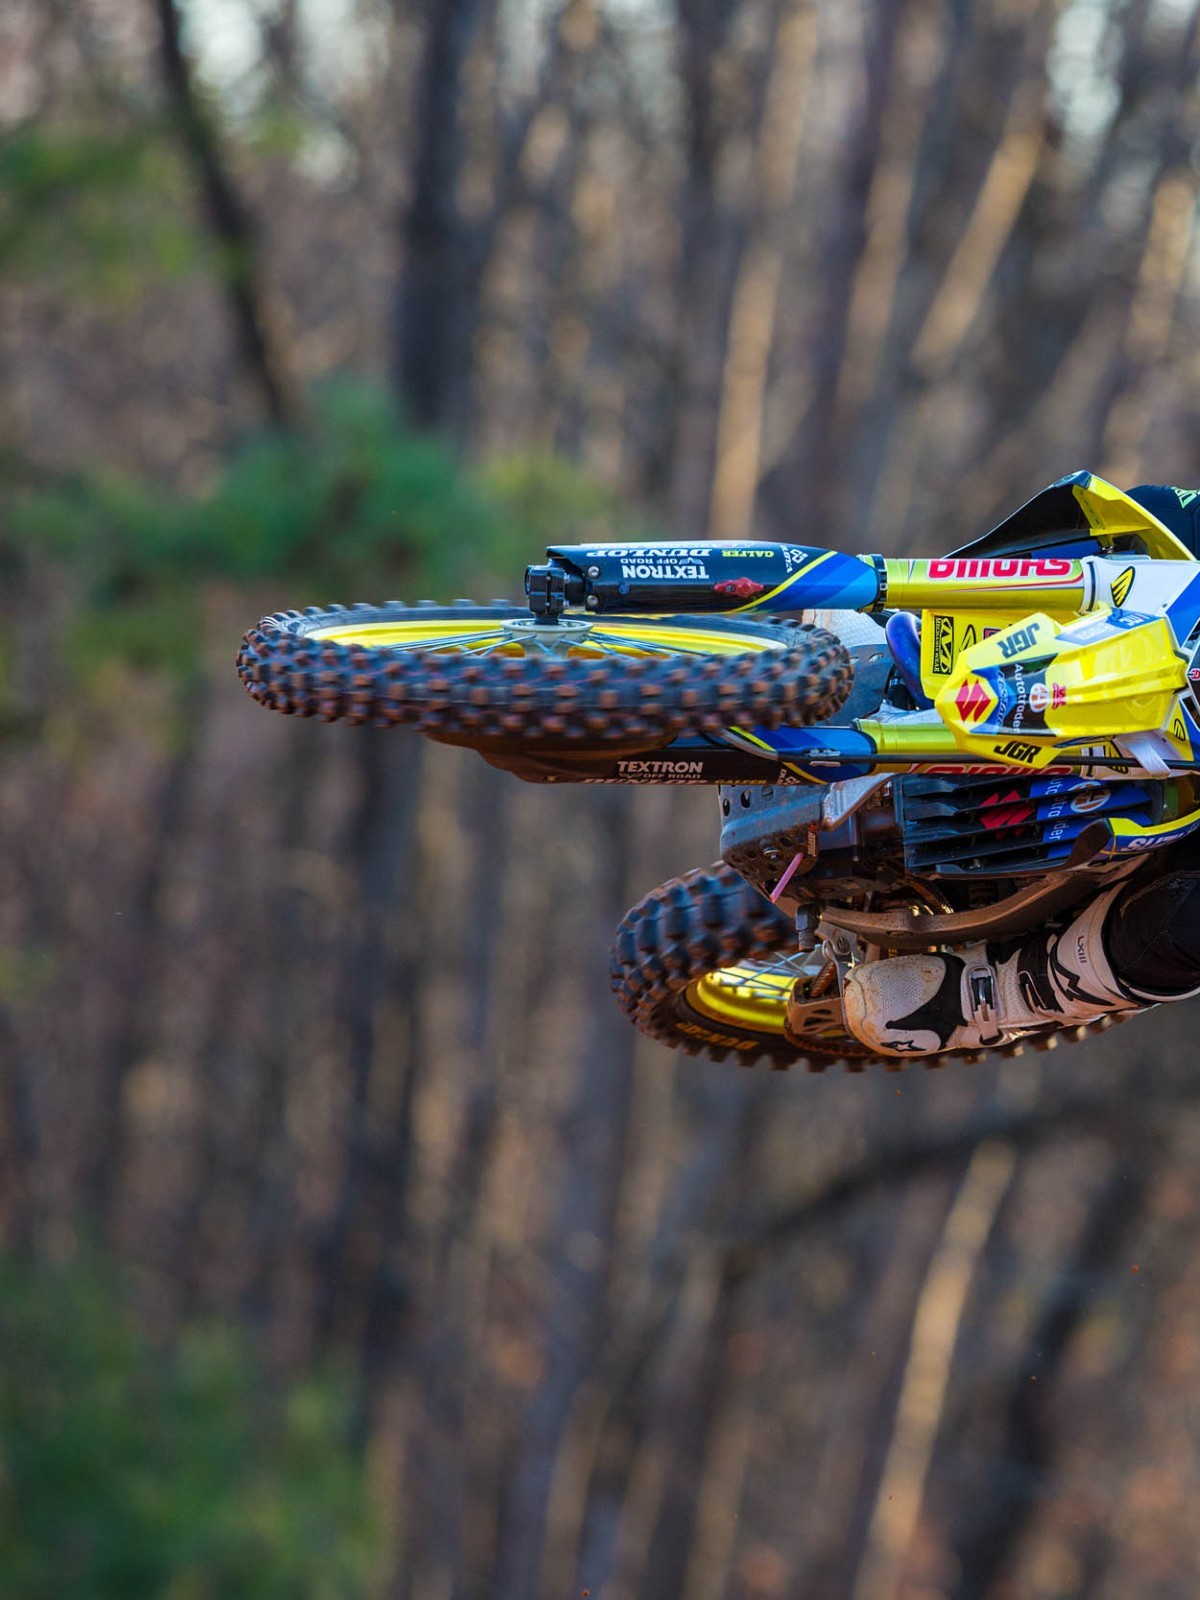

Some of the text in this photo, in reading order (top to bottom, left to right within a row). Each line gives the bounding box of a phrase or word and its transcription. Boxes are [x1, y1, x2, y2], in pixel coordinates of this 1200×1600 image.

[586, 548, 713, 558] DUNLOP
[721, 550, 775, 558] GALFER
[622, 564, 710, 580] TEXTRON
[997, 622, 1040, 659] JGR
[933, 652, 941, 672] WEAR
[1012, 663, 1027, 735] Autotrader
[994, 741, 1043, 764] JGR
[617, 761, 704, 773] TEXTRON
